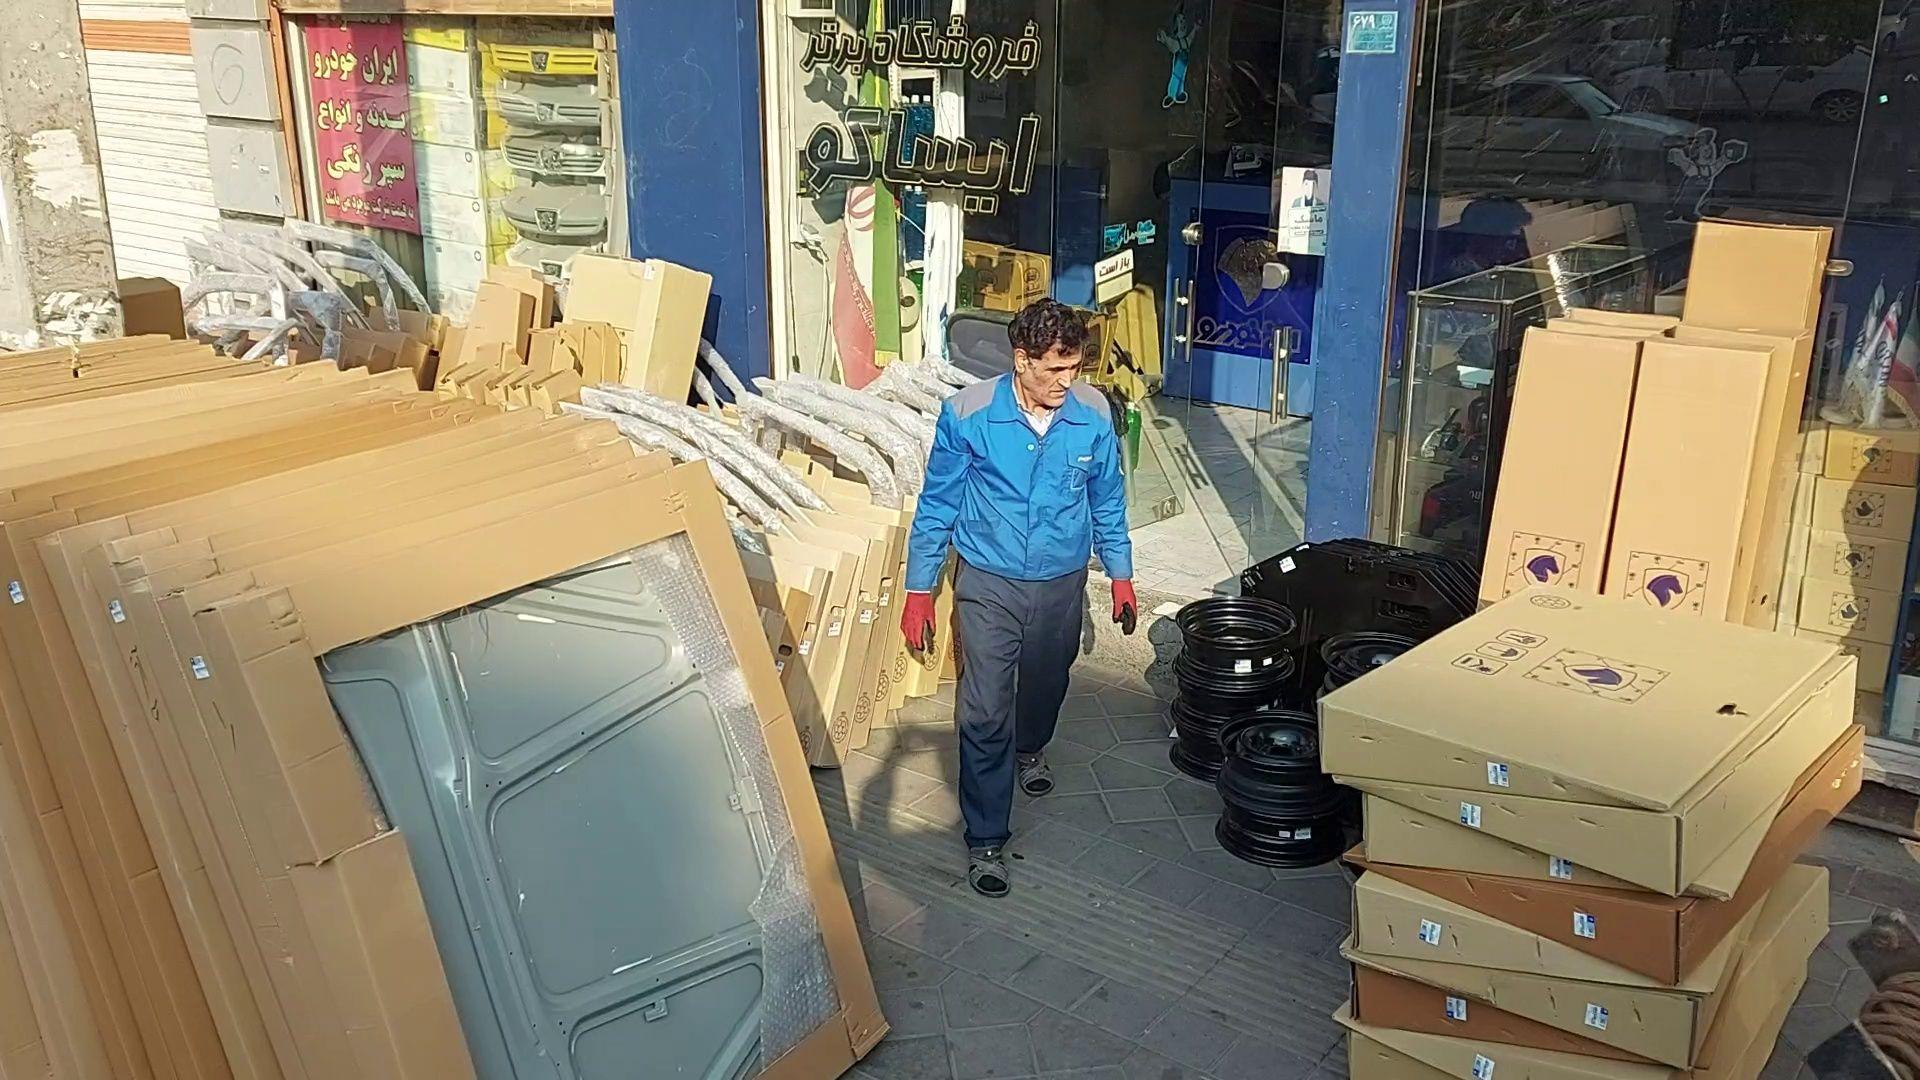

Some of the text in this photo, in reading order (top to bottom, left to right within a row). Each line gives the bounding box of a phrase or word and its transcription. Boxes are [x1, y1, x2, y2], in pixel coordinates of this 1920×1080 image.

[313, 43, 358, 82] خودرو
[362, 45, 398, 85] ایران
[800, 17, 1041, 80] فروشگاه برتر
[317, 97, 352, 131] انواع
[355, 111, 364, 133] و
[366, 101, 407, 137] بدنه
[326, 142, 373, 184] رنگی
[376, 162, 405, 189] سپر
[806, 106, 1041, 213] ایساکو
[1099, 257, 1131, 277] باز است
